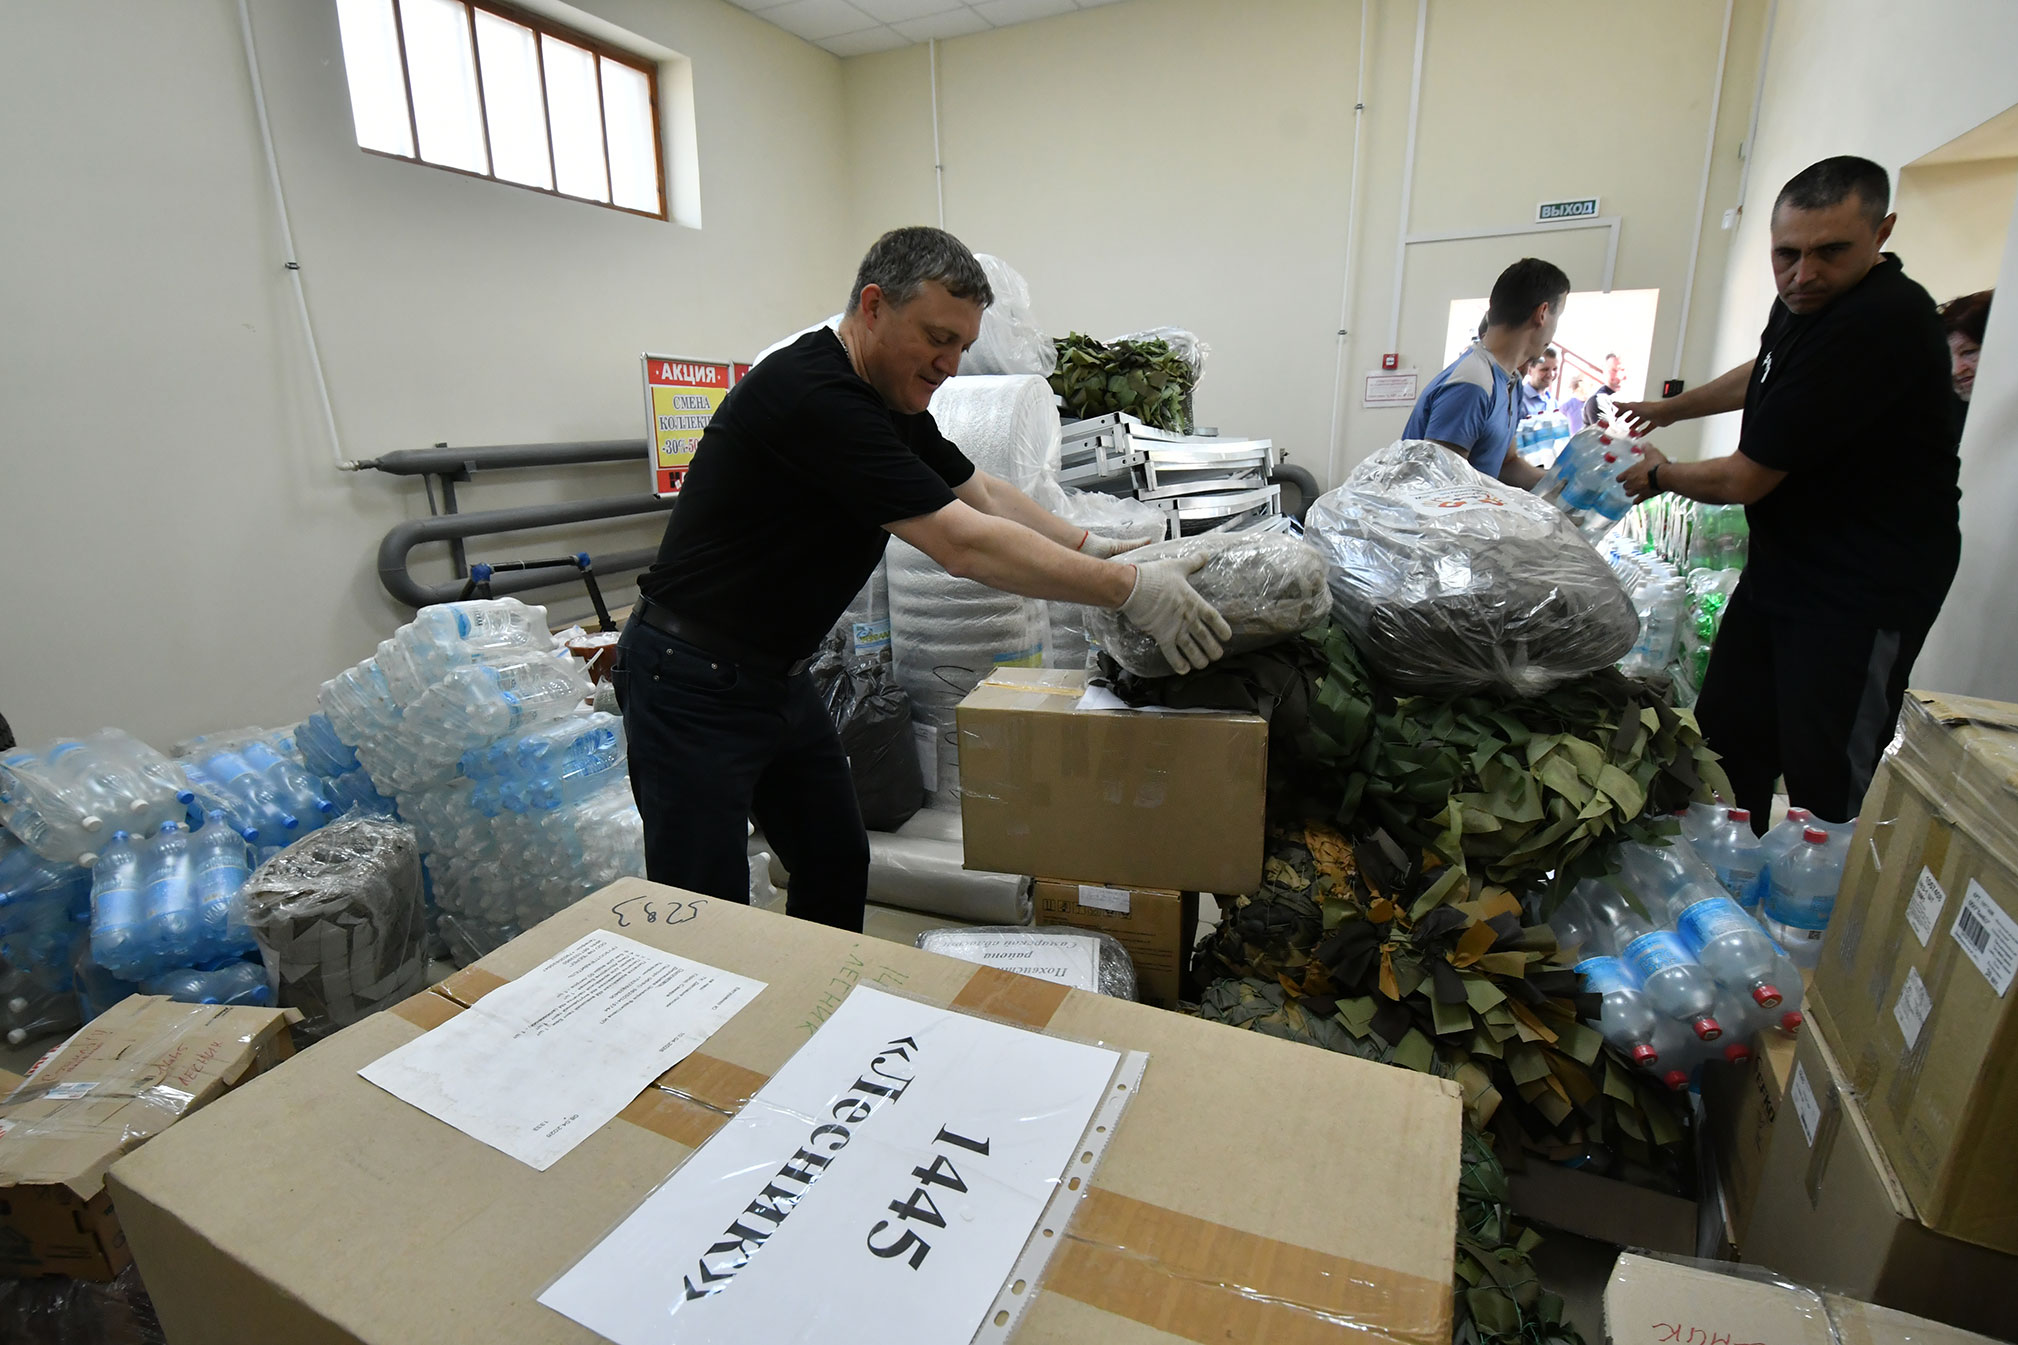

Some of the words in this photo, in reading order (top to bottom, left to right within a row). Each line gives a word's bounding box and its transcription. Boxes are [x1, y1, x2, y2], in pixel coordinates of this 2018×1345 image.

[1541, 201, 1593, 218] ВЫХОД
[661, 363, 716, 385] АКЦИЯ
[673, 395, 711, 410] СМЕНА
[983, 950, 1034, 960] района
[684, 1036, 919, 1300] «Лесник»
[867, 1123, 990, 1271] 1445
